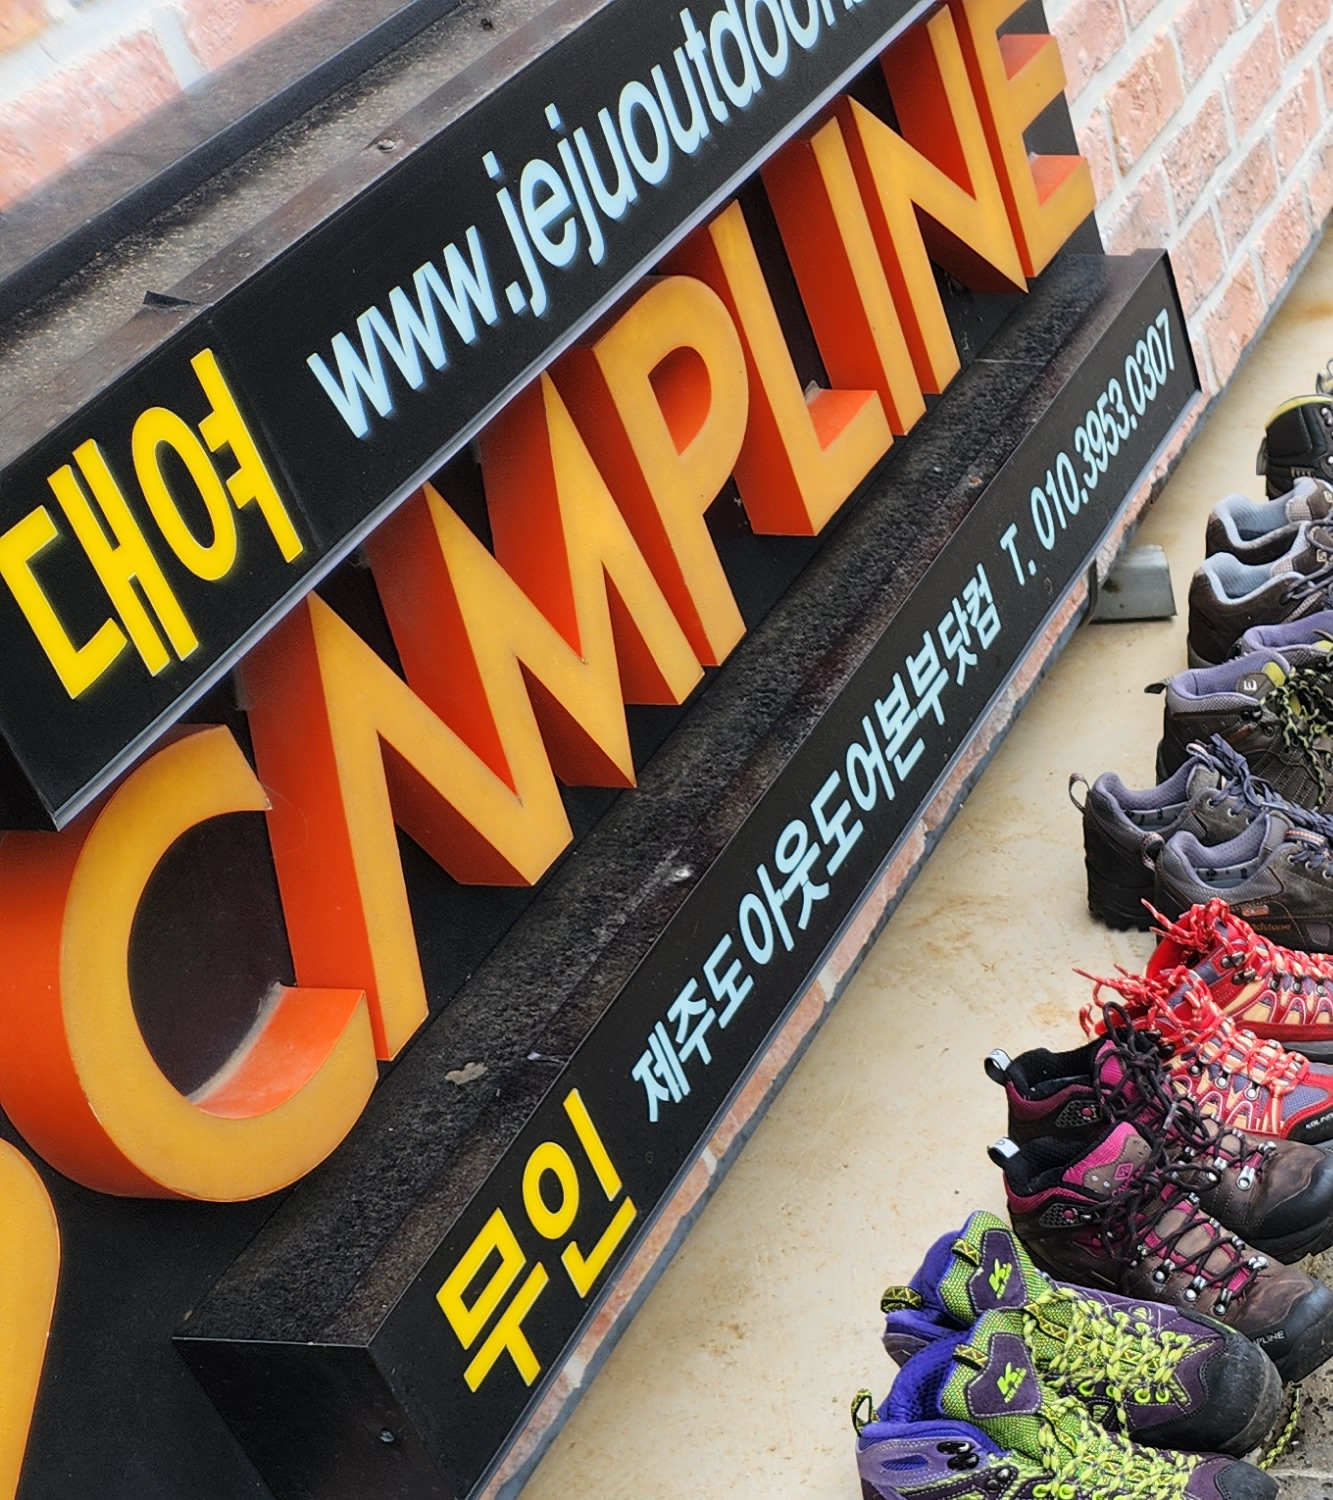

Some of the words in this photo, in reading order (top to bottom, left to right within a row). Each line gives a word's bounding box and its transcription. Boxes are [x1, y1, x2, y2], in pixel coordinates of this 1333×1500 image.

[0, 348, 303, 699] 대여
[60, 0, 1098, 1202] CAMPLINE
[436, 1087, 637, 1393] 무인
[1000, 523, 1037, 586] T.
[1030, 308, 1176, 551] 010.3953.0307
